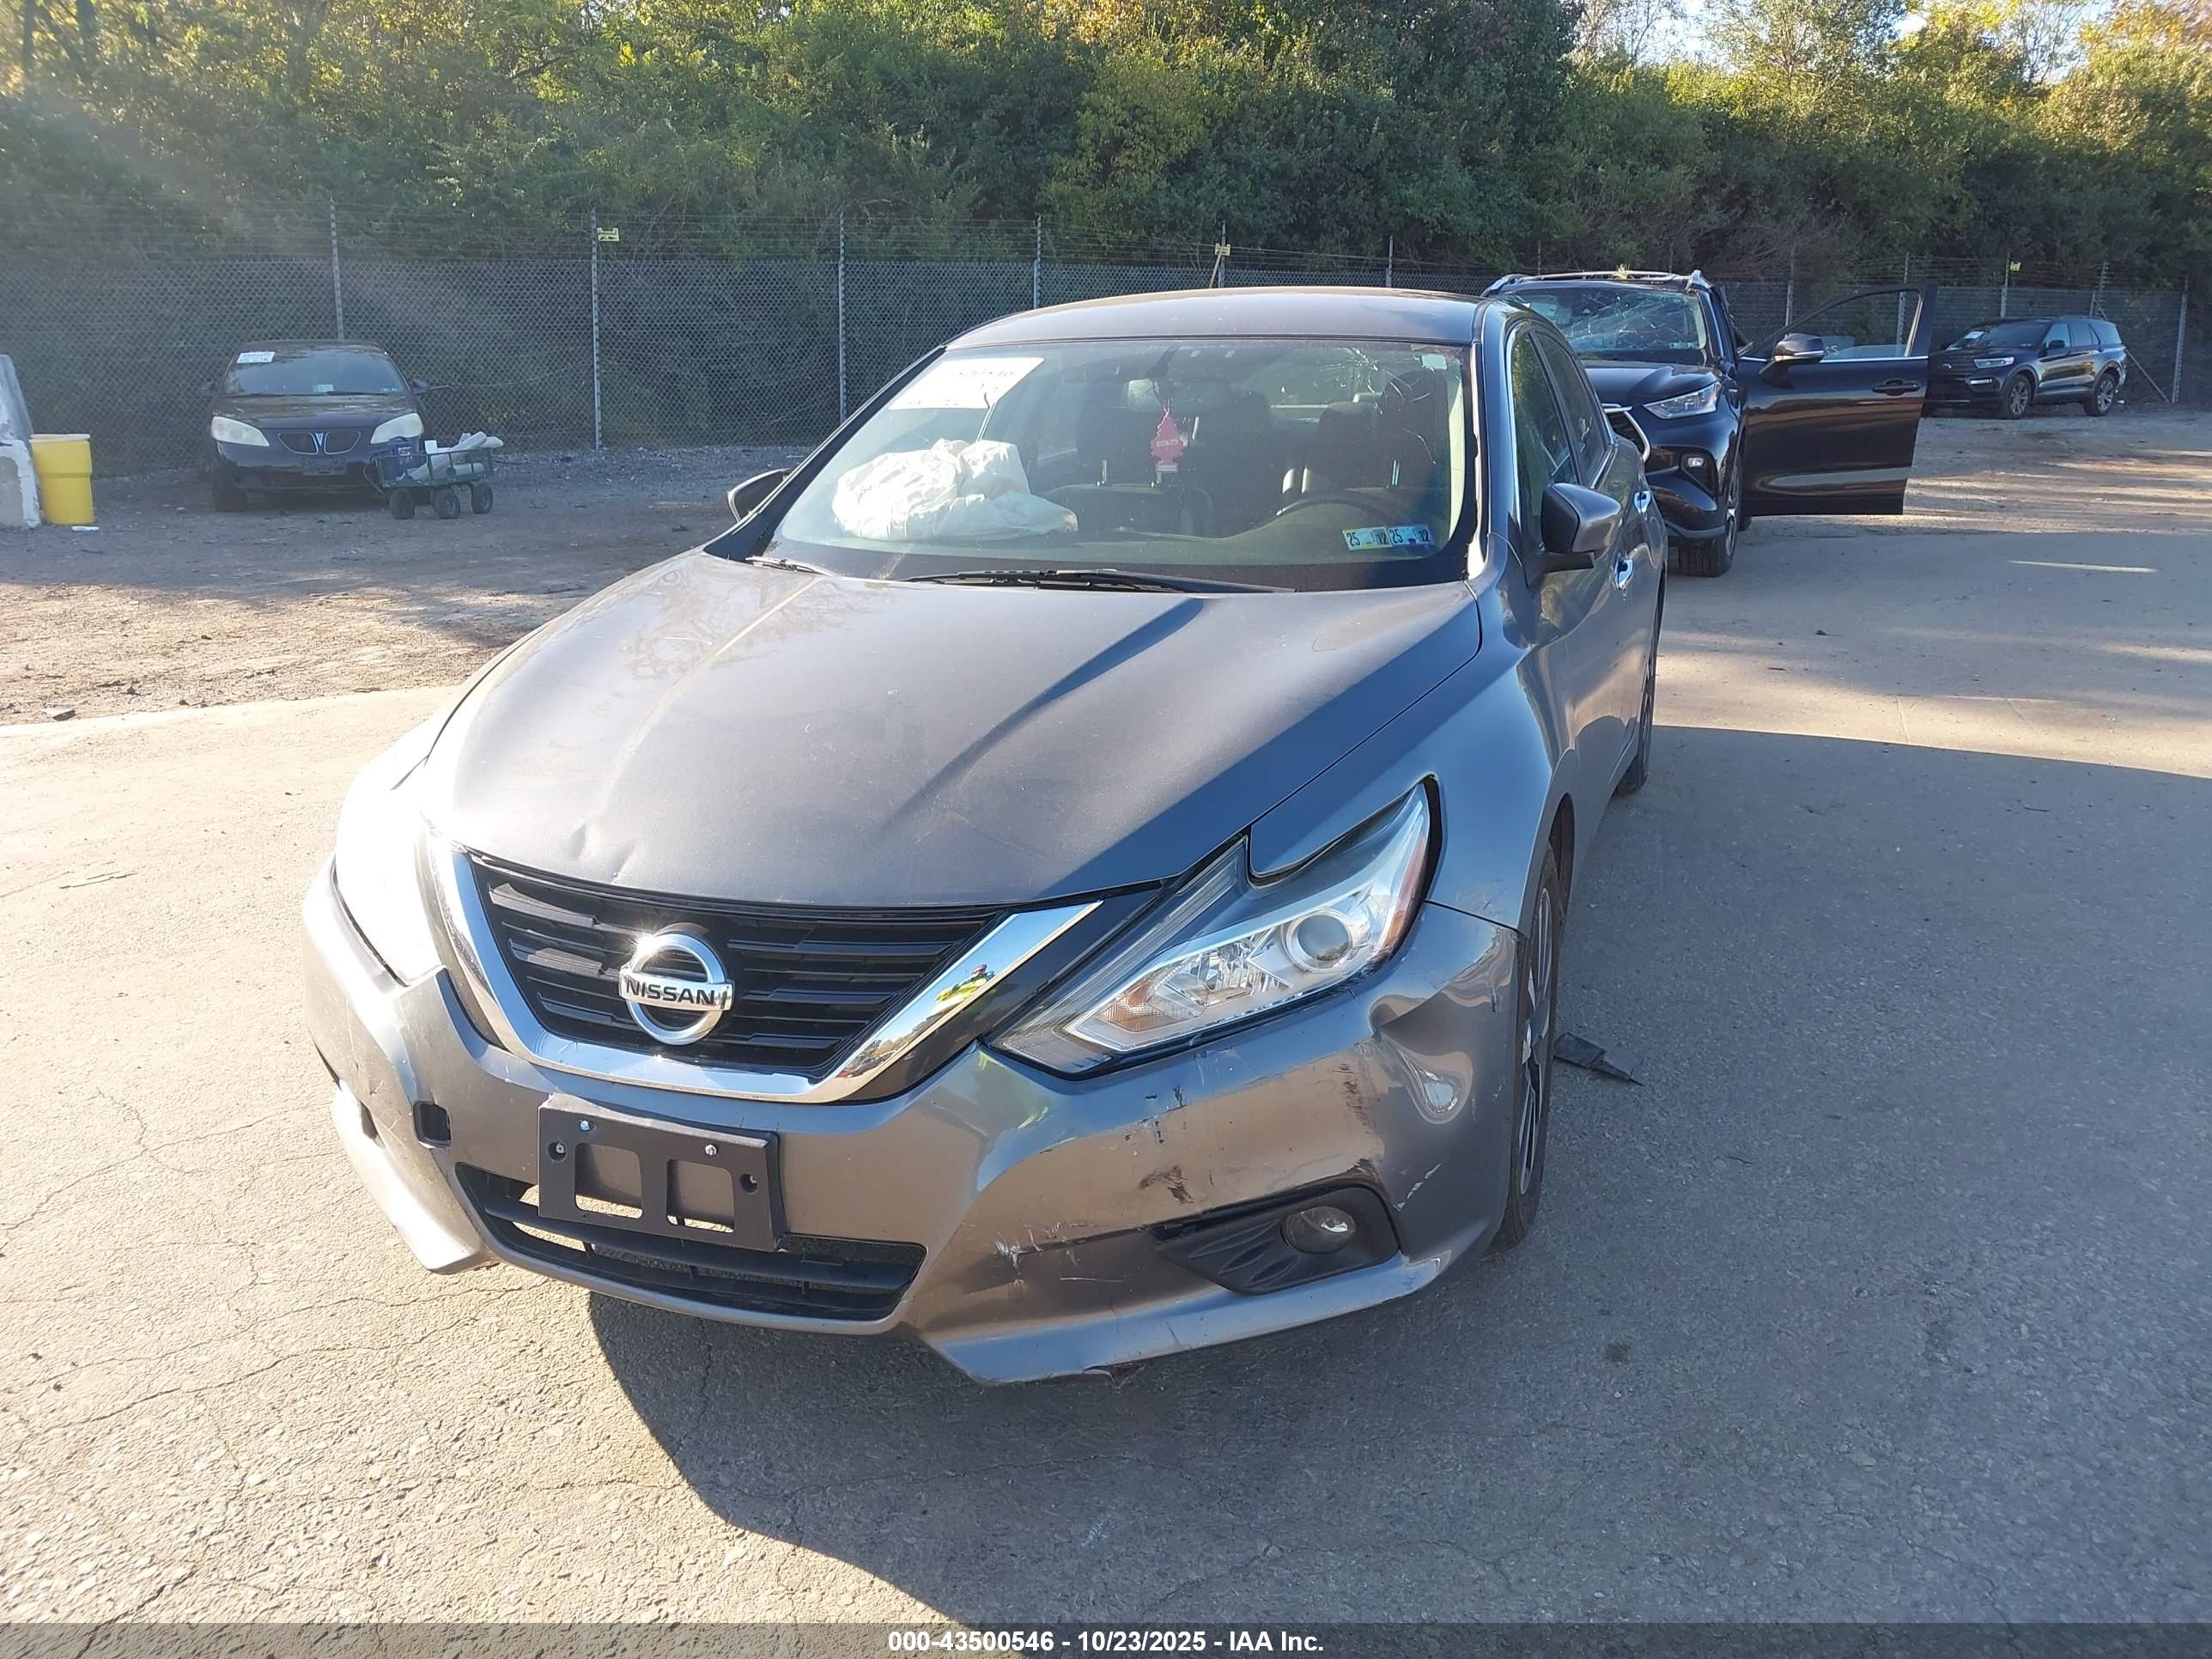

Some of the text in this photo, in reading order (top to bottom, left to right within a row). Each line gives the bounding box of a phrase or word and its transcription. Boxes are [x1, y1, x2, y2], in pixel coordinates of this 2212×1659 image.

[1346, 532, 1361, 547] 25
[1389, 528, 1404, 544] 25
[626, 978, 715, 1005] NISSAN
